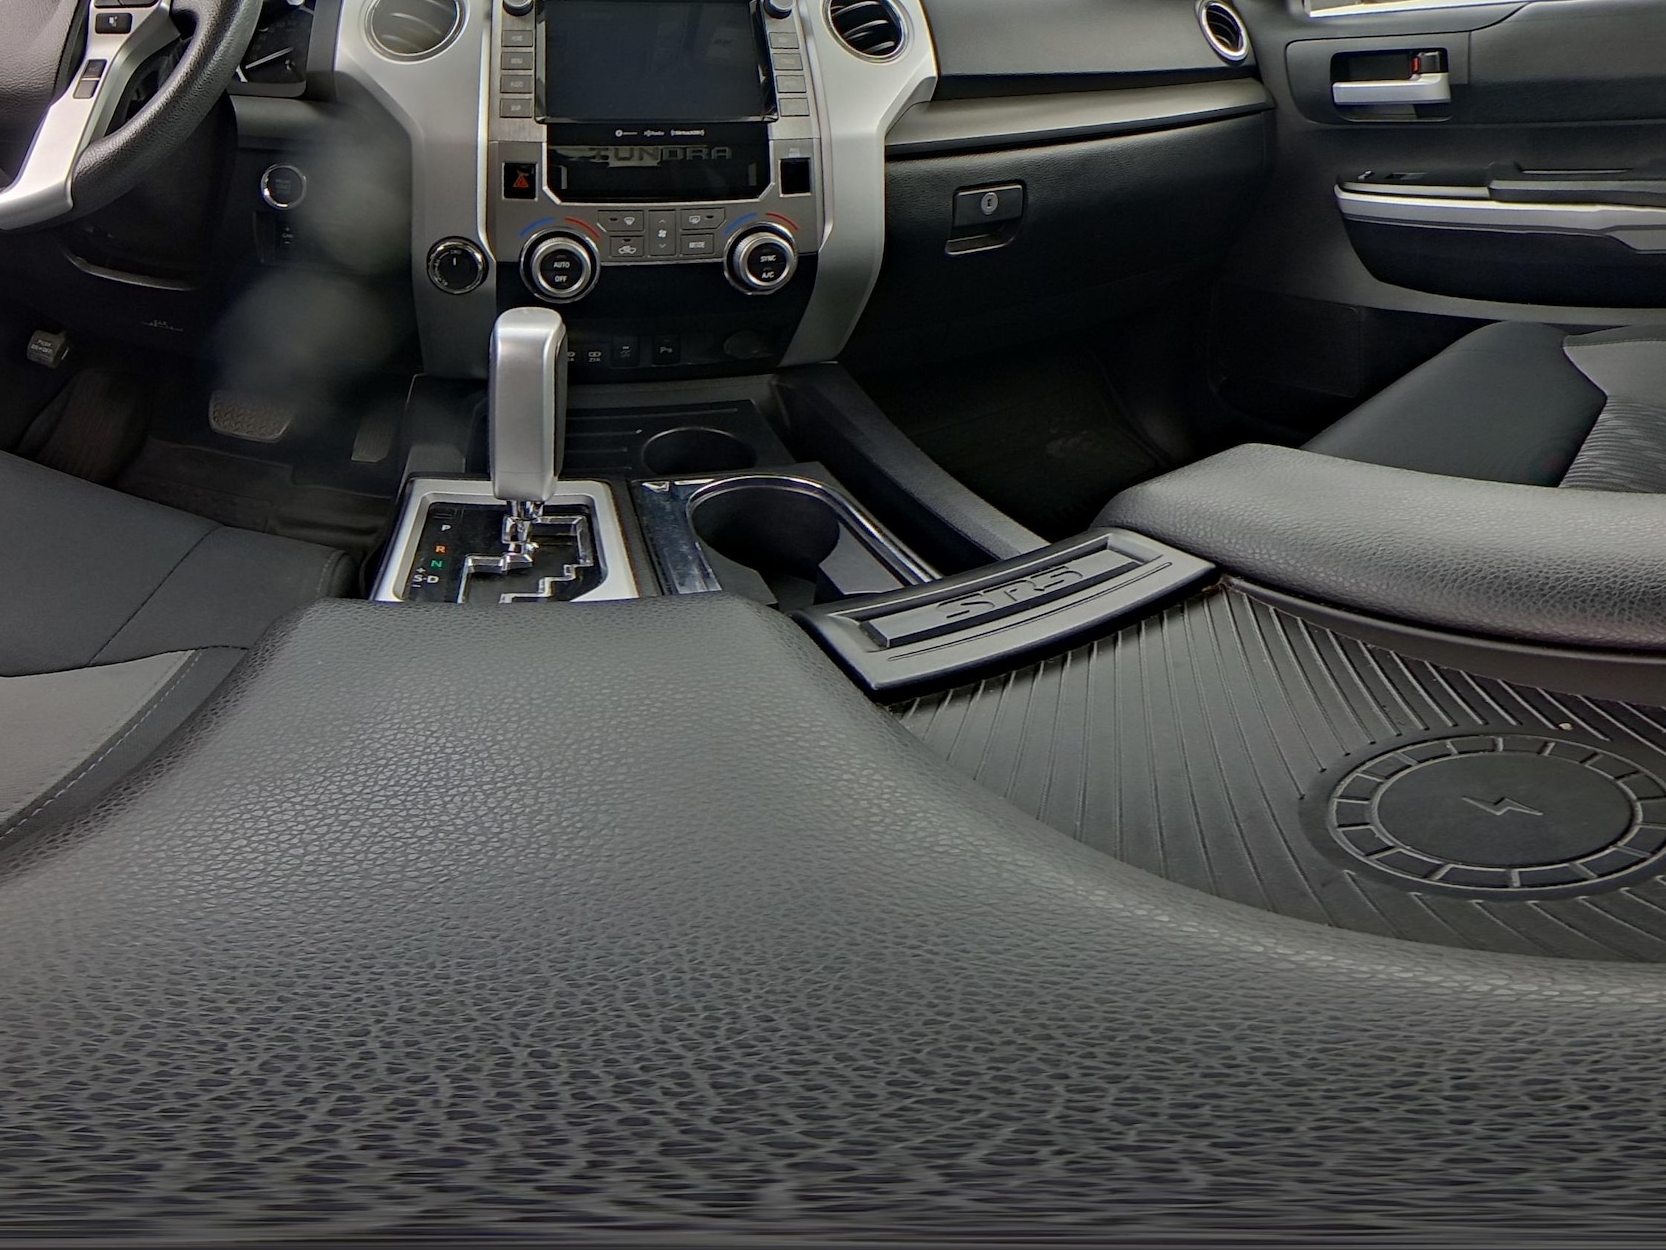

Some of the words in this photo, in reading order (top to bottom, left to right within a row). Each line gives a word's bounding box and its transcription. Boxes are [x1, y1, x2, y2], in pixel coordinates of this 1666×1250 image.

[589, 146, 733, 161] TUNDRA
[760, 254, 777, 262] SYNC
[937, 565, 1083, 618] SR5
